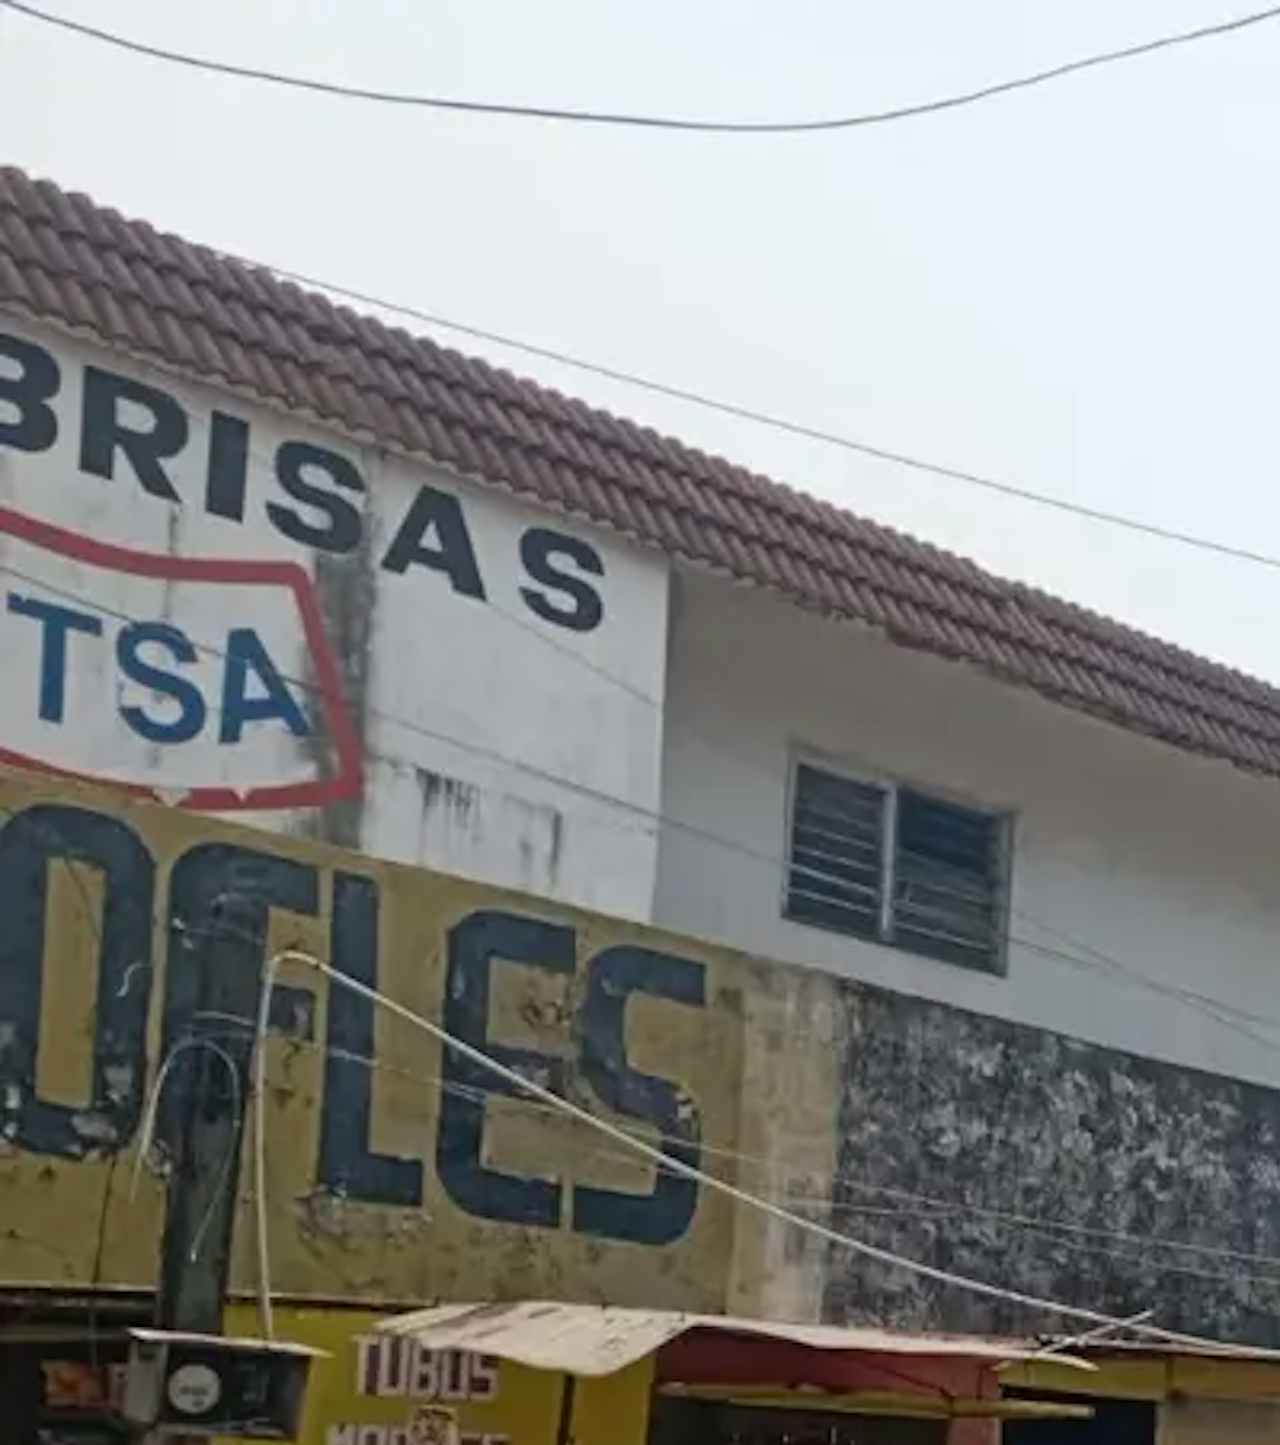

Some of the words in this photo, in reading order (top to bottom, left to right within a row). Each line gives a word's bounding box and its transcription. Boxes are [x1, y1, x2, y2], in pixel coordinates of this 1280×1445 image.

[0, 333, 605, 632] BRISAS
[7, 590, 312, 745] TSA
[353, 1334, 499, 1402] TUBOS
